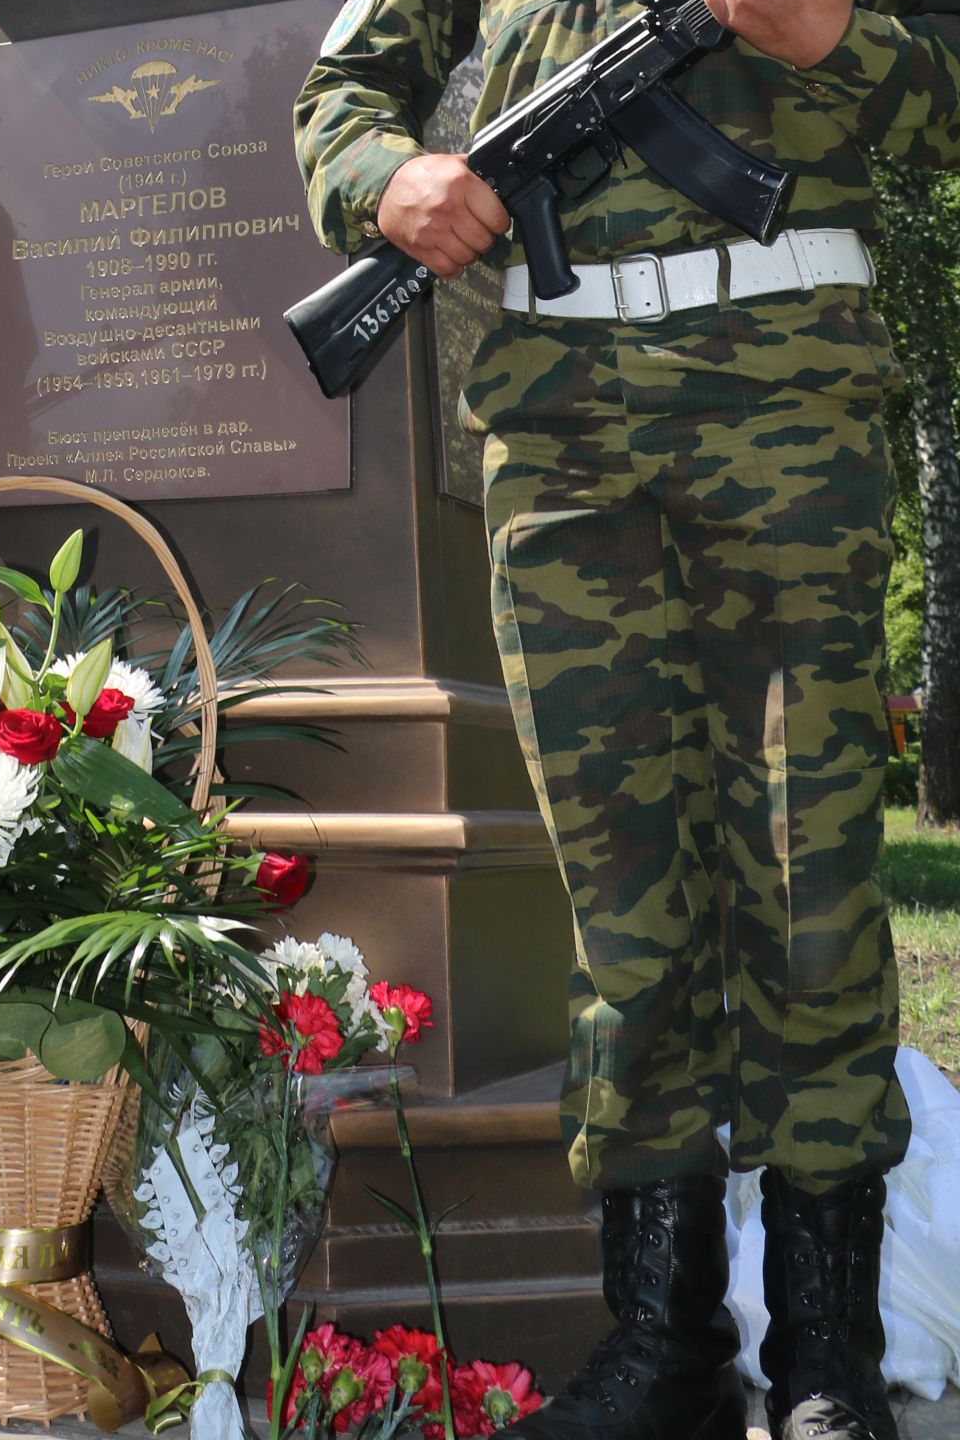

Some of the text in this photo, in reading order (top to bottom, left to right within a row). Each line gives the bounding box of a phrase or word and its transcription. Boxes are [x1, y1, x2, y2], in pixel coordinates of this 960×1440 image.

[136, 37, 192, 55] КРОМЕ
[196, 41, 234, 64] НАС!
[99, 148, 201, 173] Советского
[207, 140, 268, 159] Союза
[119, 168, 188, 194] (1944 г.)
[79, 186, 228, 224] МАРГЕЛОВ
[11, 214, 300, 261] Василий Филиппович
[197, 250, 218, 267] гг.
[80, 276, 223, 302] Генерал армии,
[85, 295, 218, 322] командующий
[44, 316, 261, 348] Воздушно-десантными
[77, 339, 226, 367] войсками СССР
[241, 359, 268, 381] гг.)
[47, 421, 253, 446] Бюст преподнесён в дар.
[6, 439, 297, 471] Проект «Аллея Российской Славы»
[123, 465, 211, 483] Сердюков.
